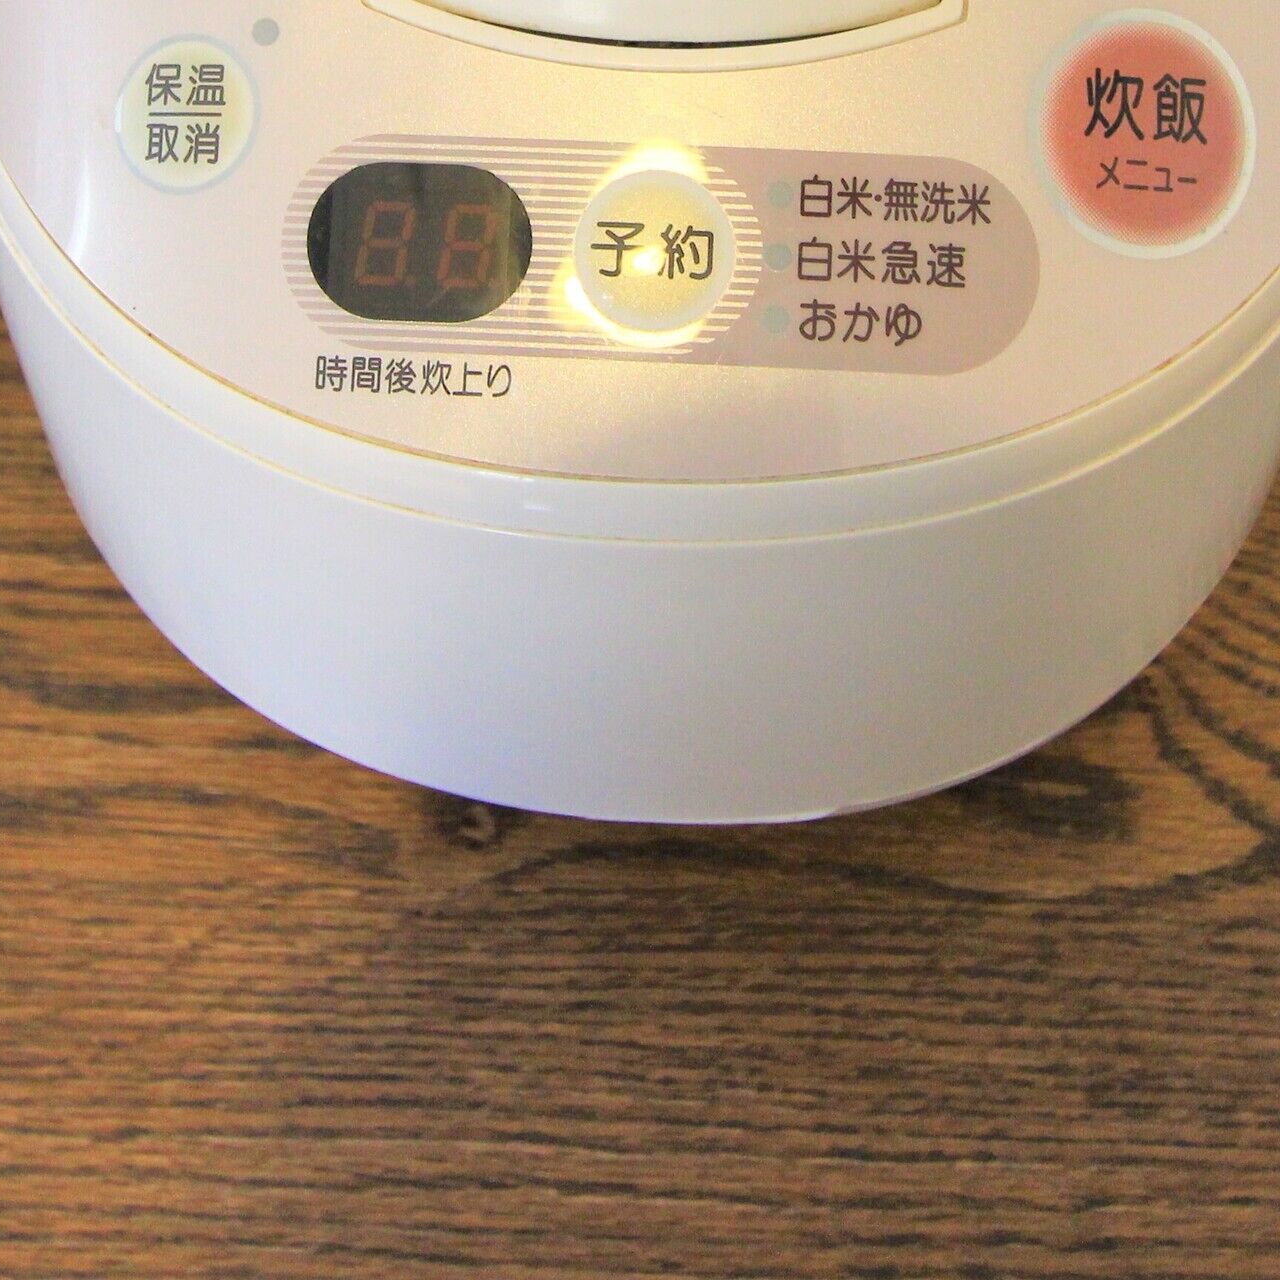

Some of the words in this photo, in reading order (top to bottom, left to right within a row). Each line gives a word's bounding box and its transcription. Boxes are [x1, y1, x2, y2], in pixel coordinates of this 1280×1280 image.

[145, 63, 226, 106] 保温
[1085, 68, 1208, 145] 炊飯
[145, 122, 220, 164] 取消
[1096, 157, 1197, 192] メニュー
[590, 221, 715, 280] 予約
[798, 236, 965, 288] 白米急速
[799, 299, 922, 346] おかゆ
[315, 355, 512, 398] 時間後炊上り
